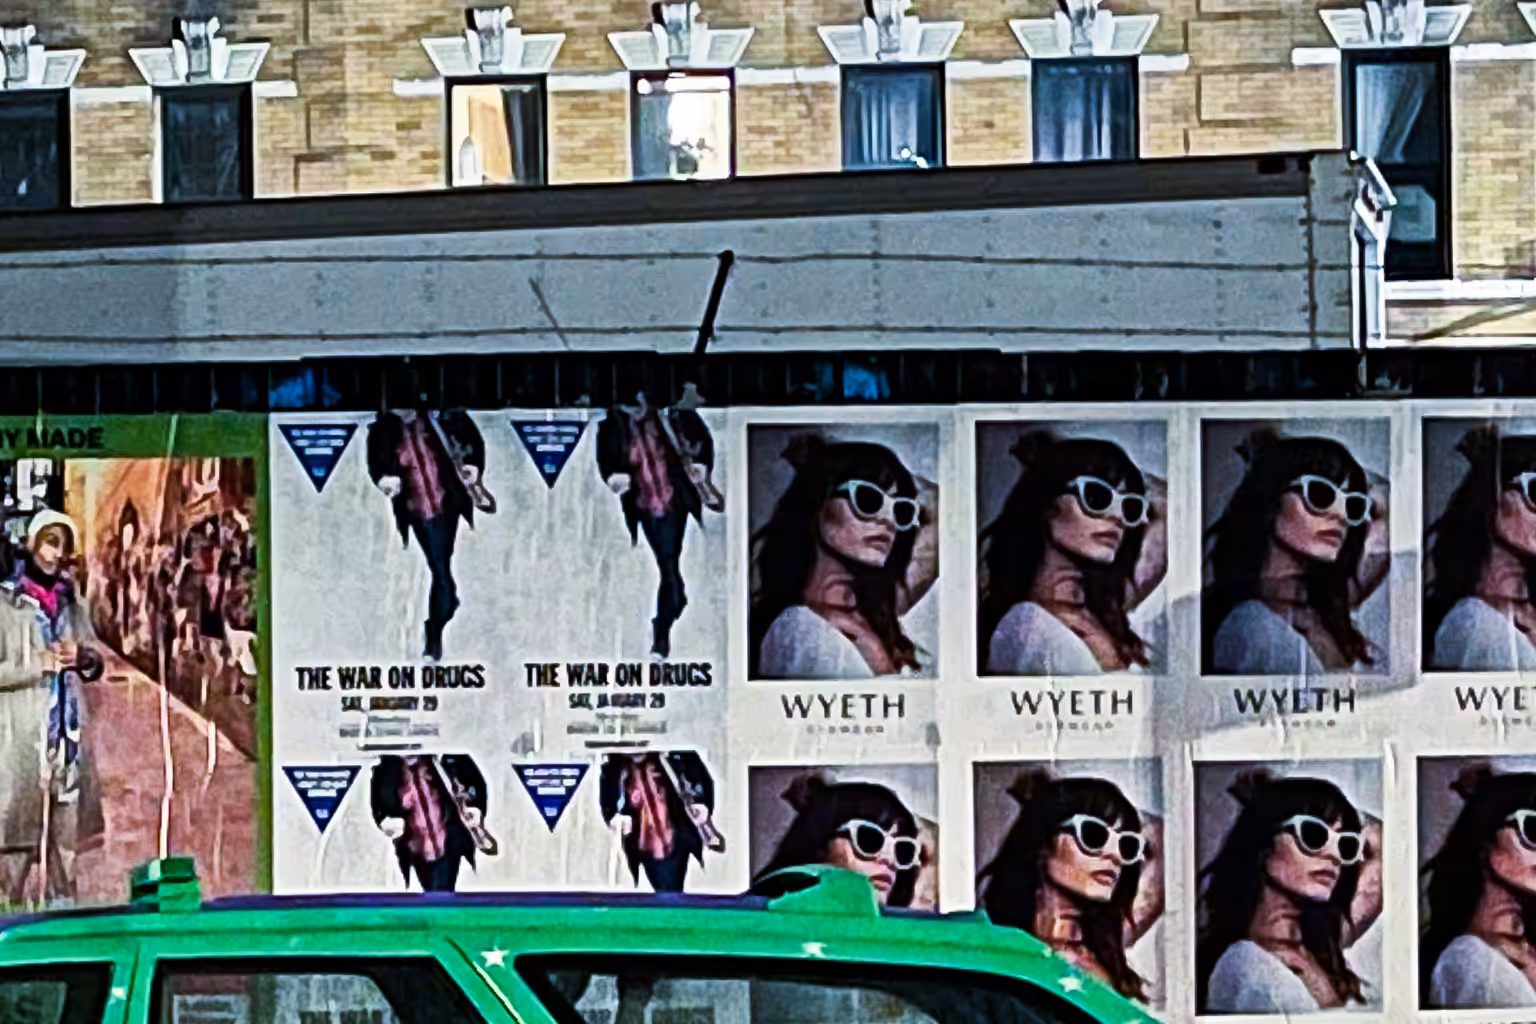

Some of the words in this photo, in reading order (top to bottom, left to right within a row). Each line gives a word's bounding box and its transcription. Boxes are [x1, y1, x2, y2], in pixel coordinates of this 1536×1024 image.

[27, 427, 104, 449] MADE
[295, 666, 332, 690] THE
[337, 666, 382, 690] WAR
[388, 666, 415, 689] ON
[422, 664, 486, 689] DRUGS
[524, 663, 560, 687] THE
[567, 663, 609, 687] WAR
[615, 663, 642, 687] ON
[649, 662, 713, 687] DRUGS
[781, 694, 905, 719] WYETH
[1011, 690, 1133, 716] WYETH
[1234, 688, 1355, 714] WYETH
[1455, 686, 1536, 712] WYE
